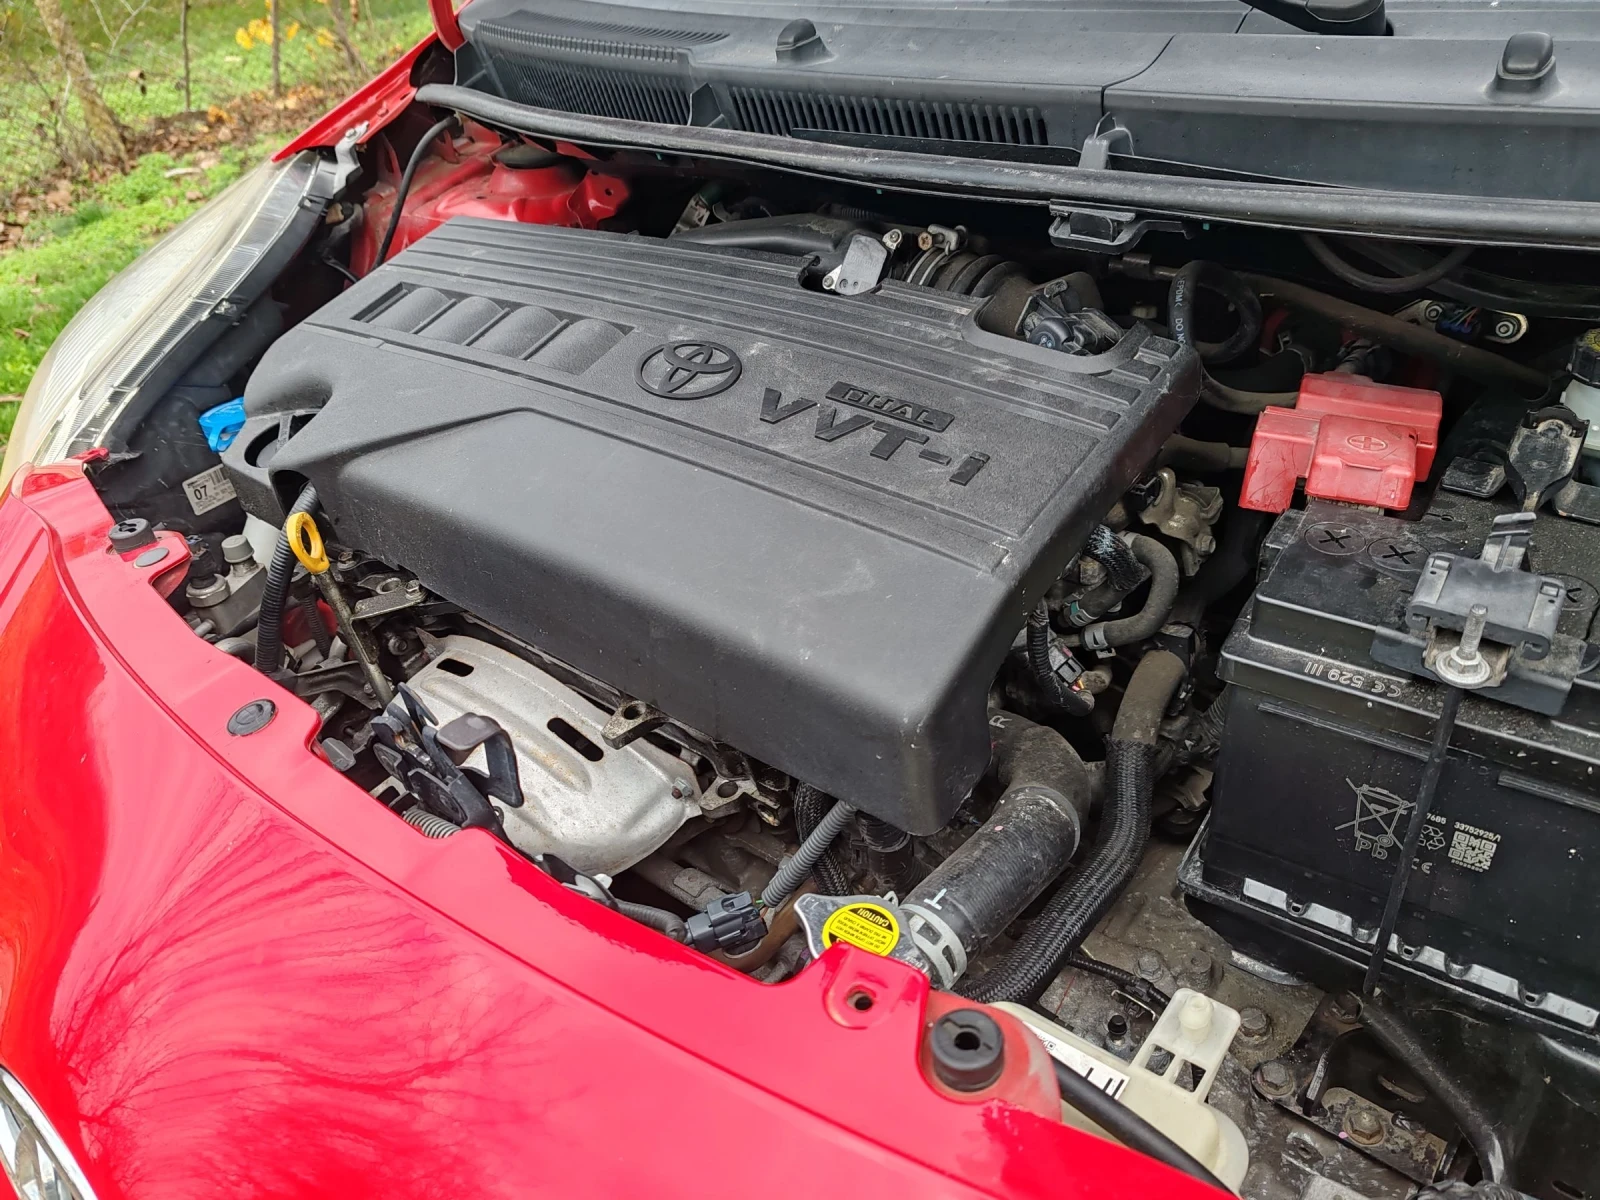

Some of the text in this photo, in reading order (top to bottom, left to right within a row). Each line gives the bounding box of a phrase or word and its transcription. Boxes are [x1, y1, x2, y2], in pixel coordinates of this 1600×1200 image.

[1175, 318, 1184, 331] DO
[842, 386, 935, 425] DUAL
[194, 485, 208, 500] 07
[1327, 668, 1365, 689] 529
[989, 715, 1013, 729] R
[1354, 838, 1388, 860] Pb
[857, 908, 890, 927] CAUTION
